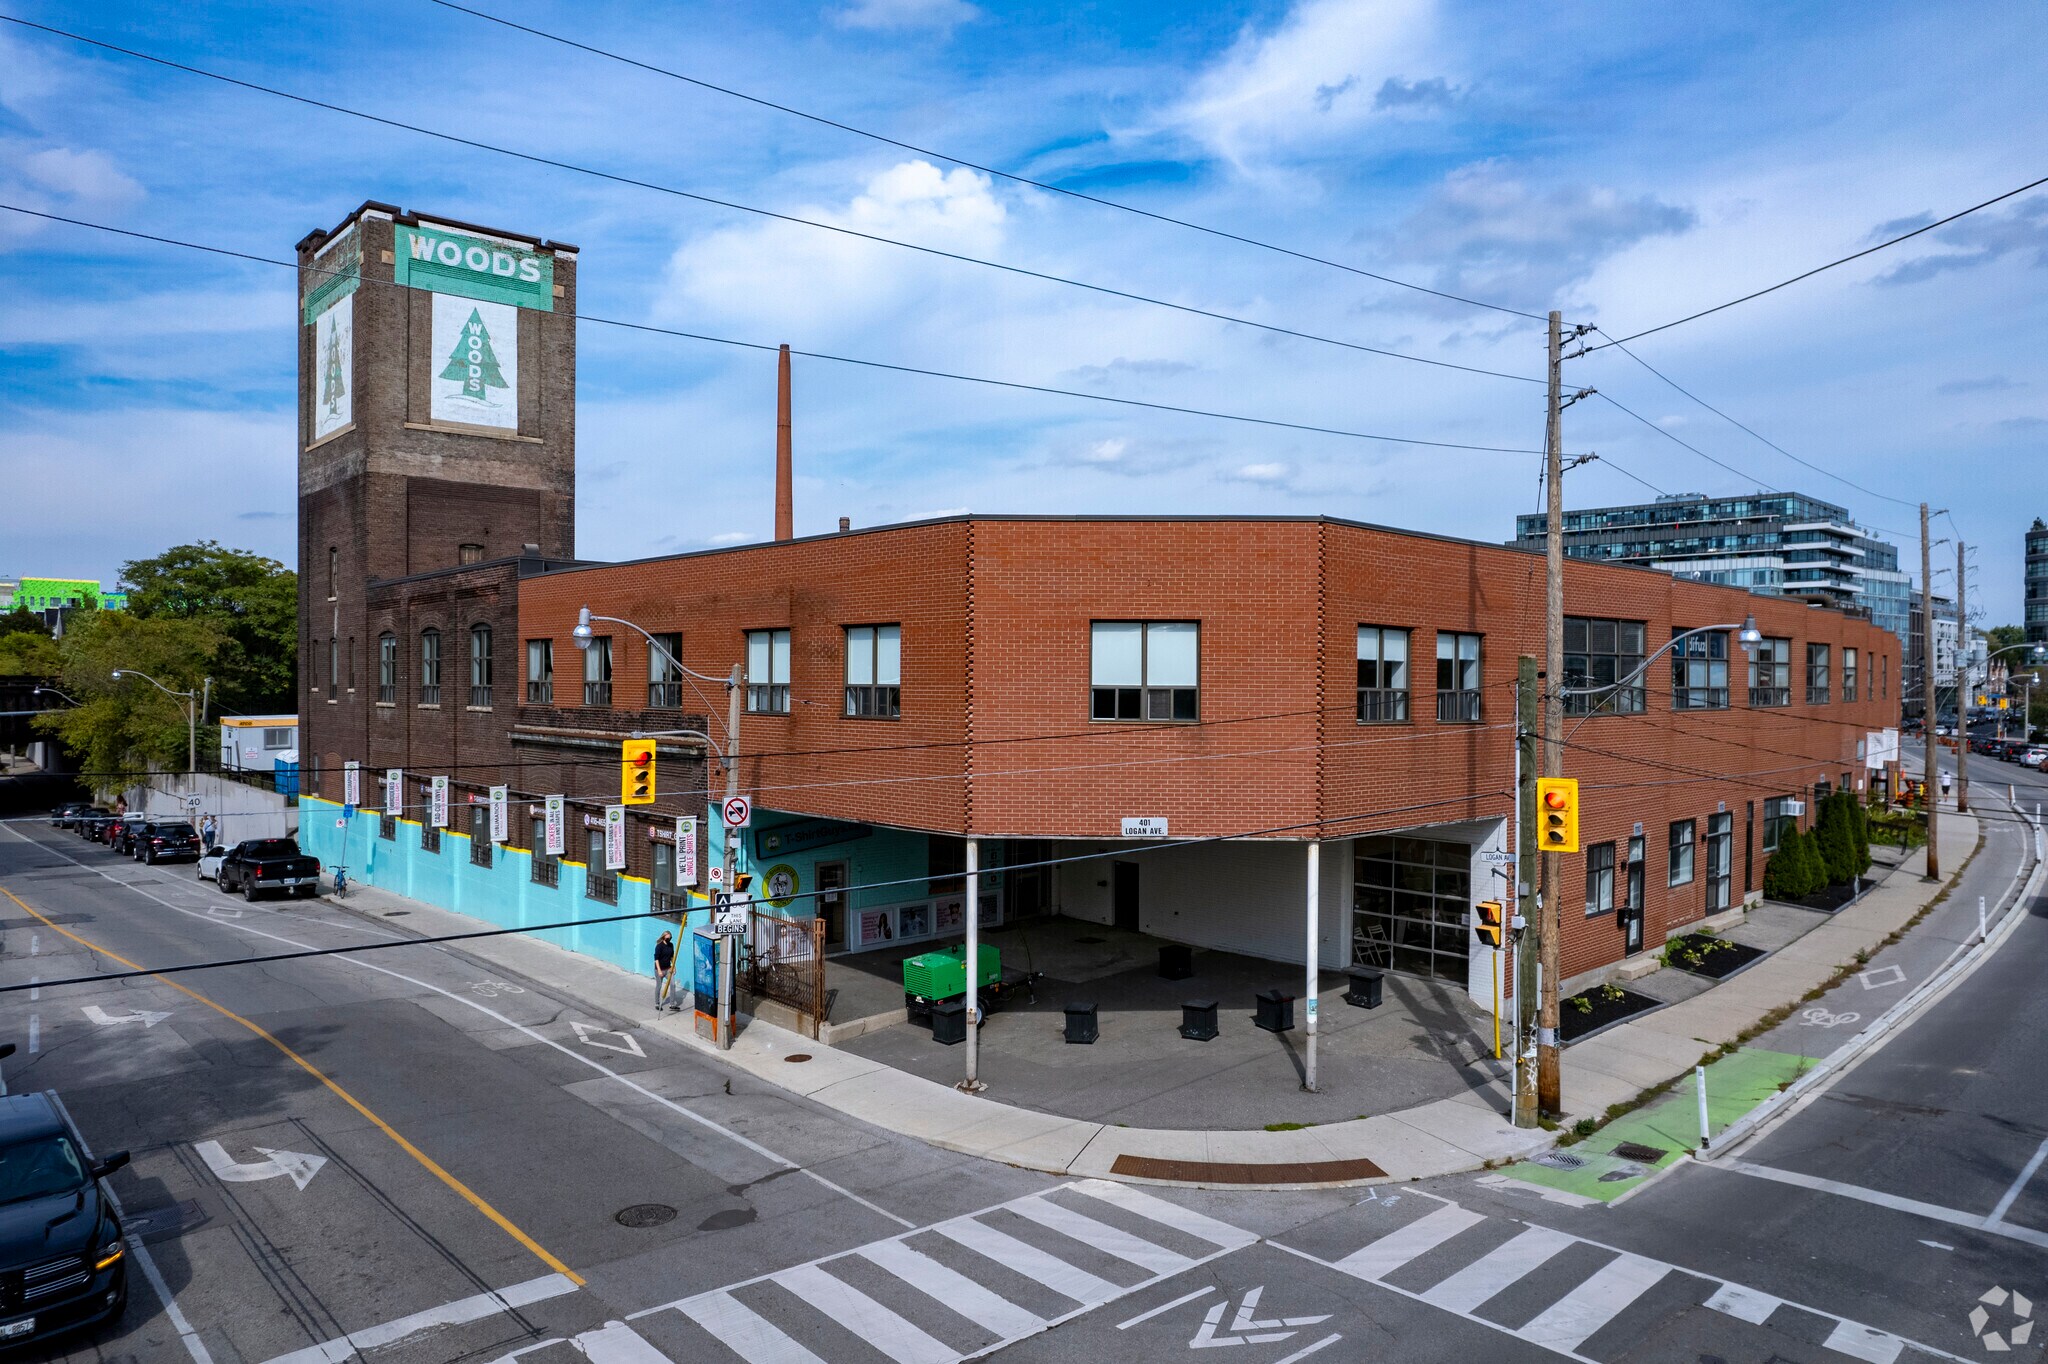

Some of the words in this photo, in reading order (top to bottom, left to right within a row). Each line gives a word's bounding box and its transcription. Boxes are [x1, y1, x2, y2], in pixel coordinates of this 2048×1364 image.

[408, 233, 541, 282] WOODS
[468, 322, 482, 392] WOODS
[188, 798, 200, 806] 40
[718, 924, 744, 932] BEGINS
